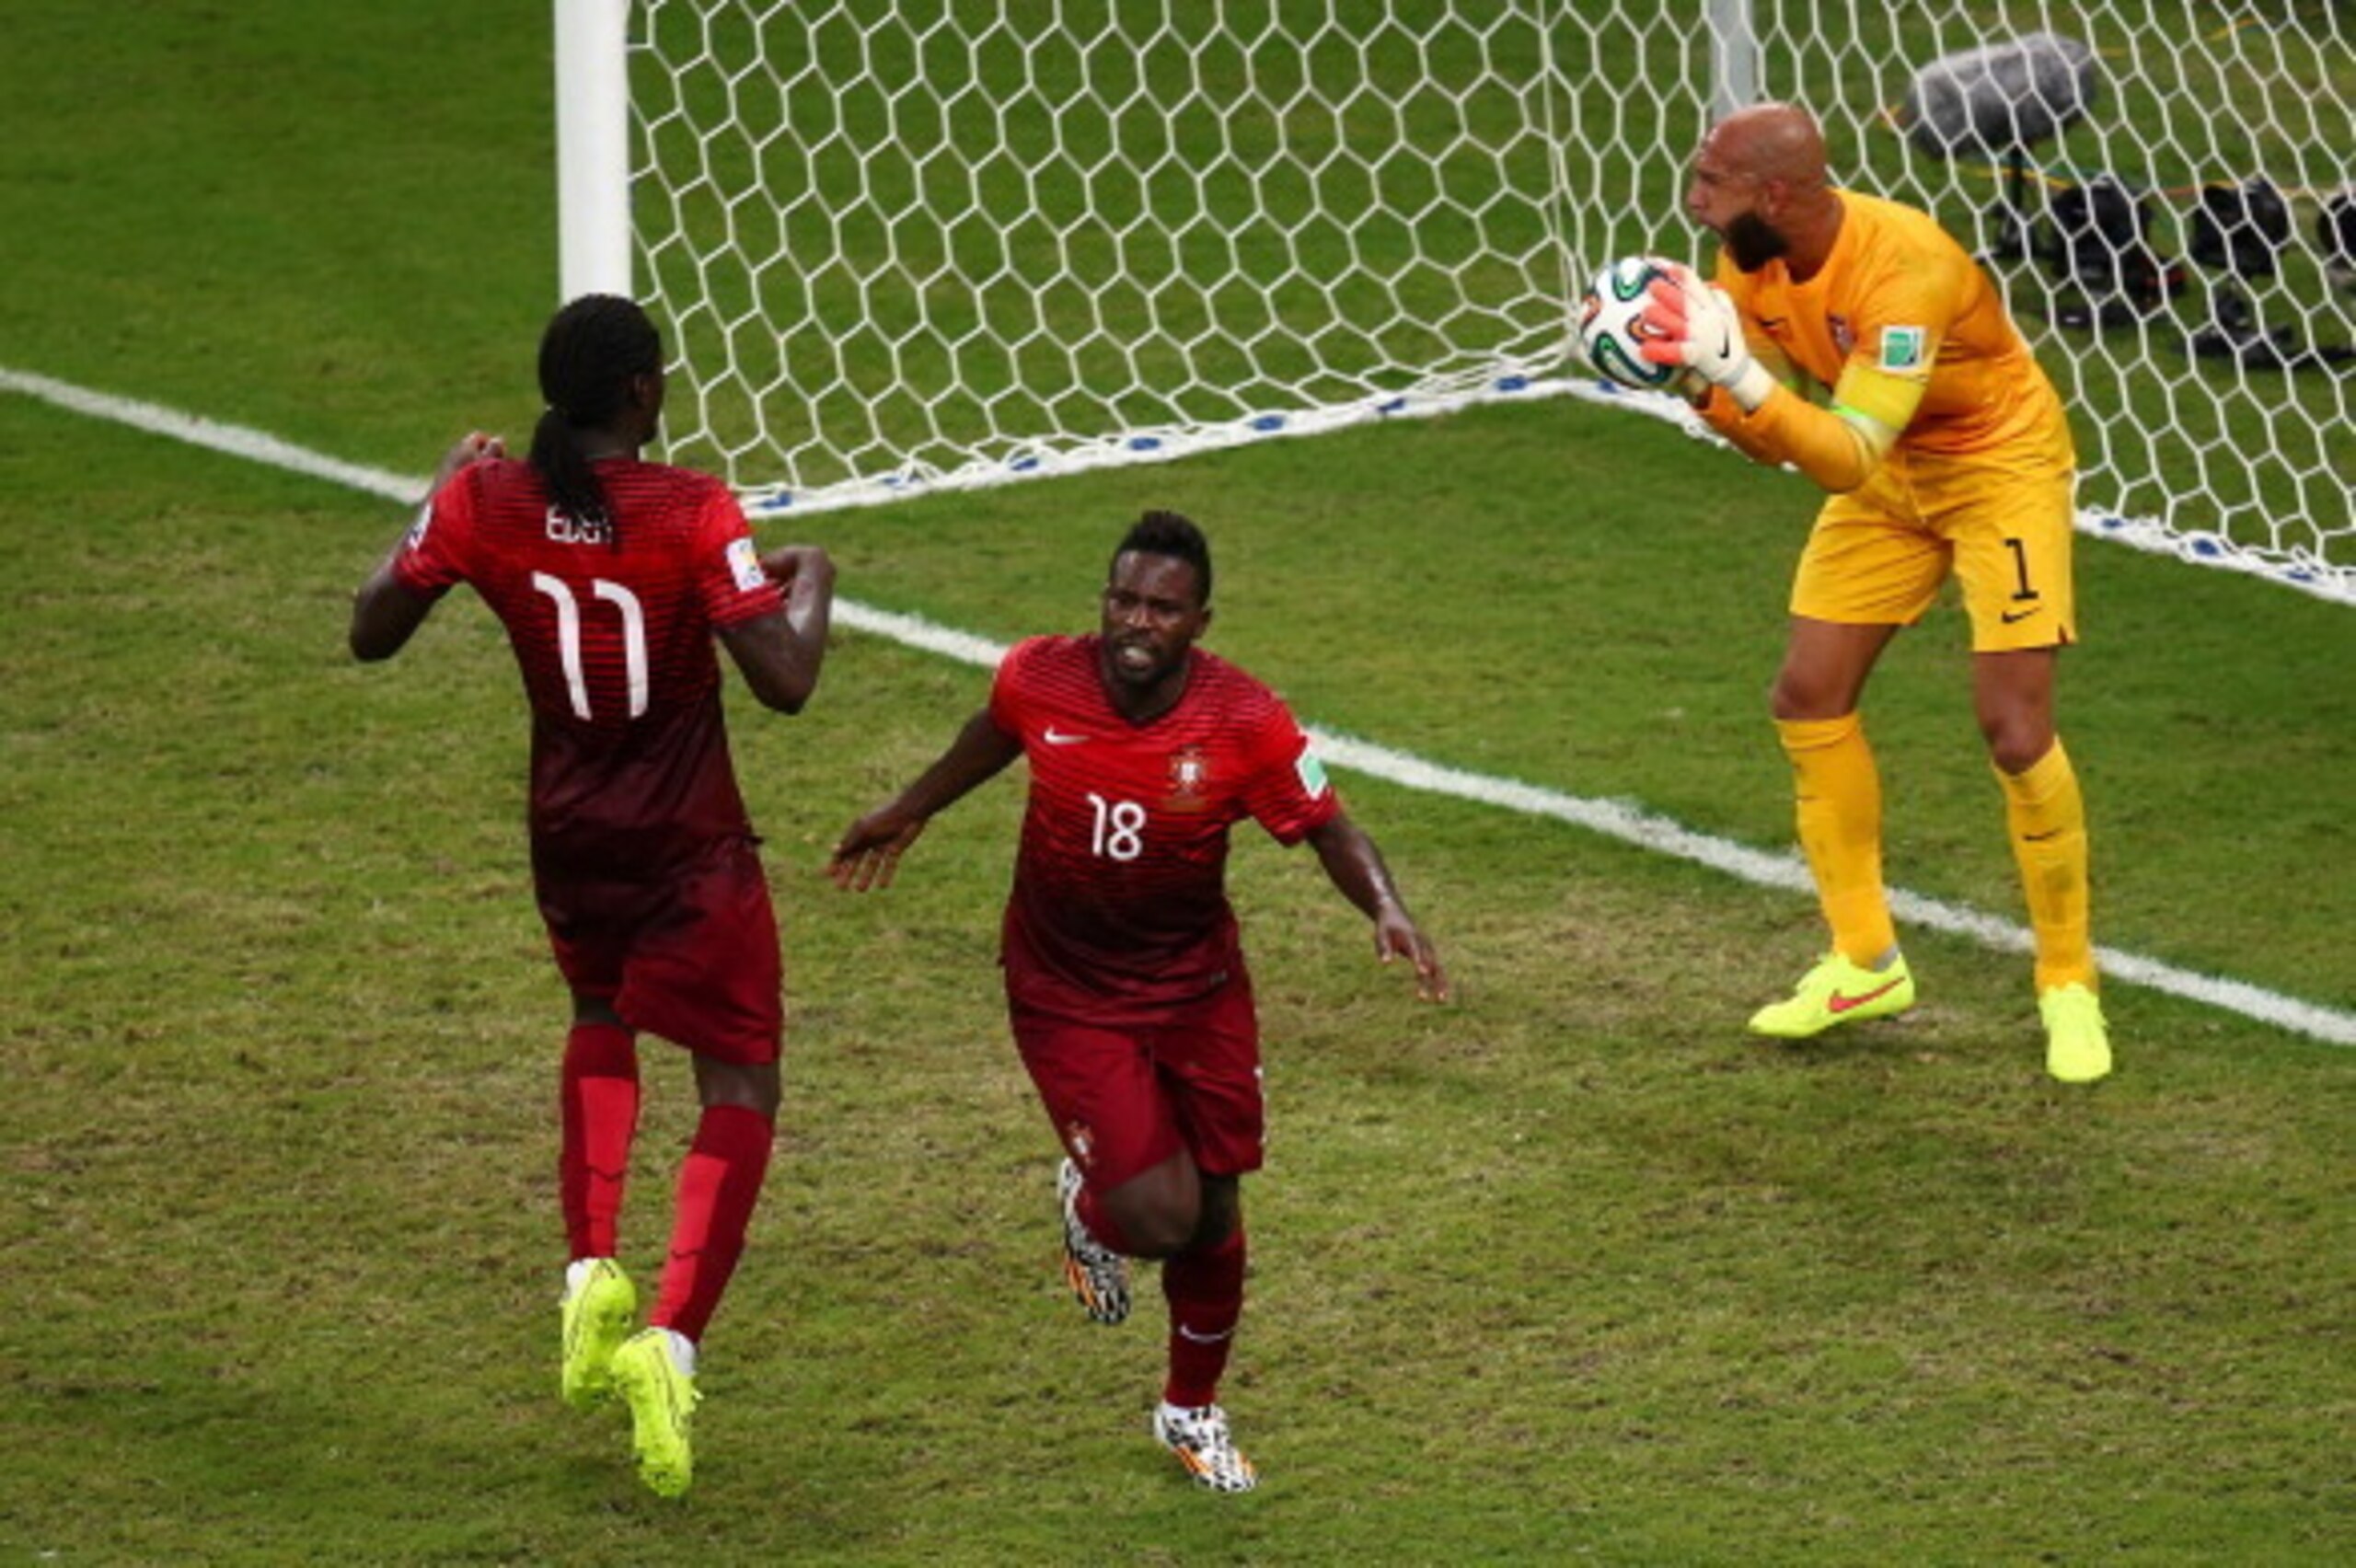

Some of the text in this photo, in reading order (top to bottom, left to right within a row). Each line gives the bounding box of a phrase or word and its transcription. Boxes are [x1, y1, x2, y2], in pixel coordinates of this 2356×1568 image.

[2004, 537, 2038, 602] 1
[532, 570, 648, 721] 11
[1087, 791, 1147, 861] 18
